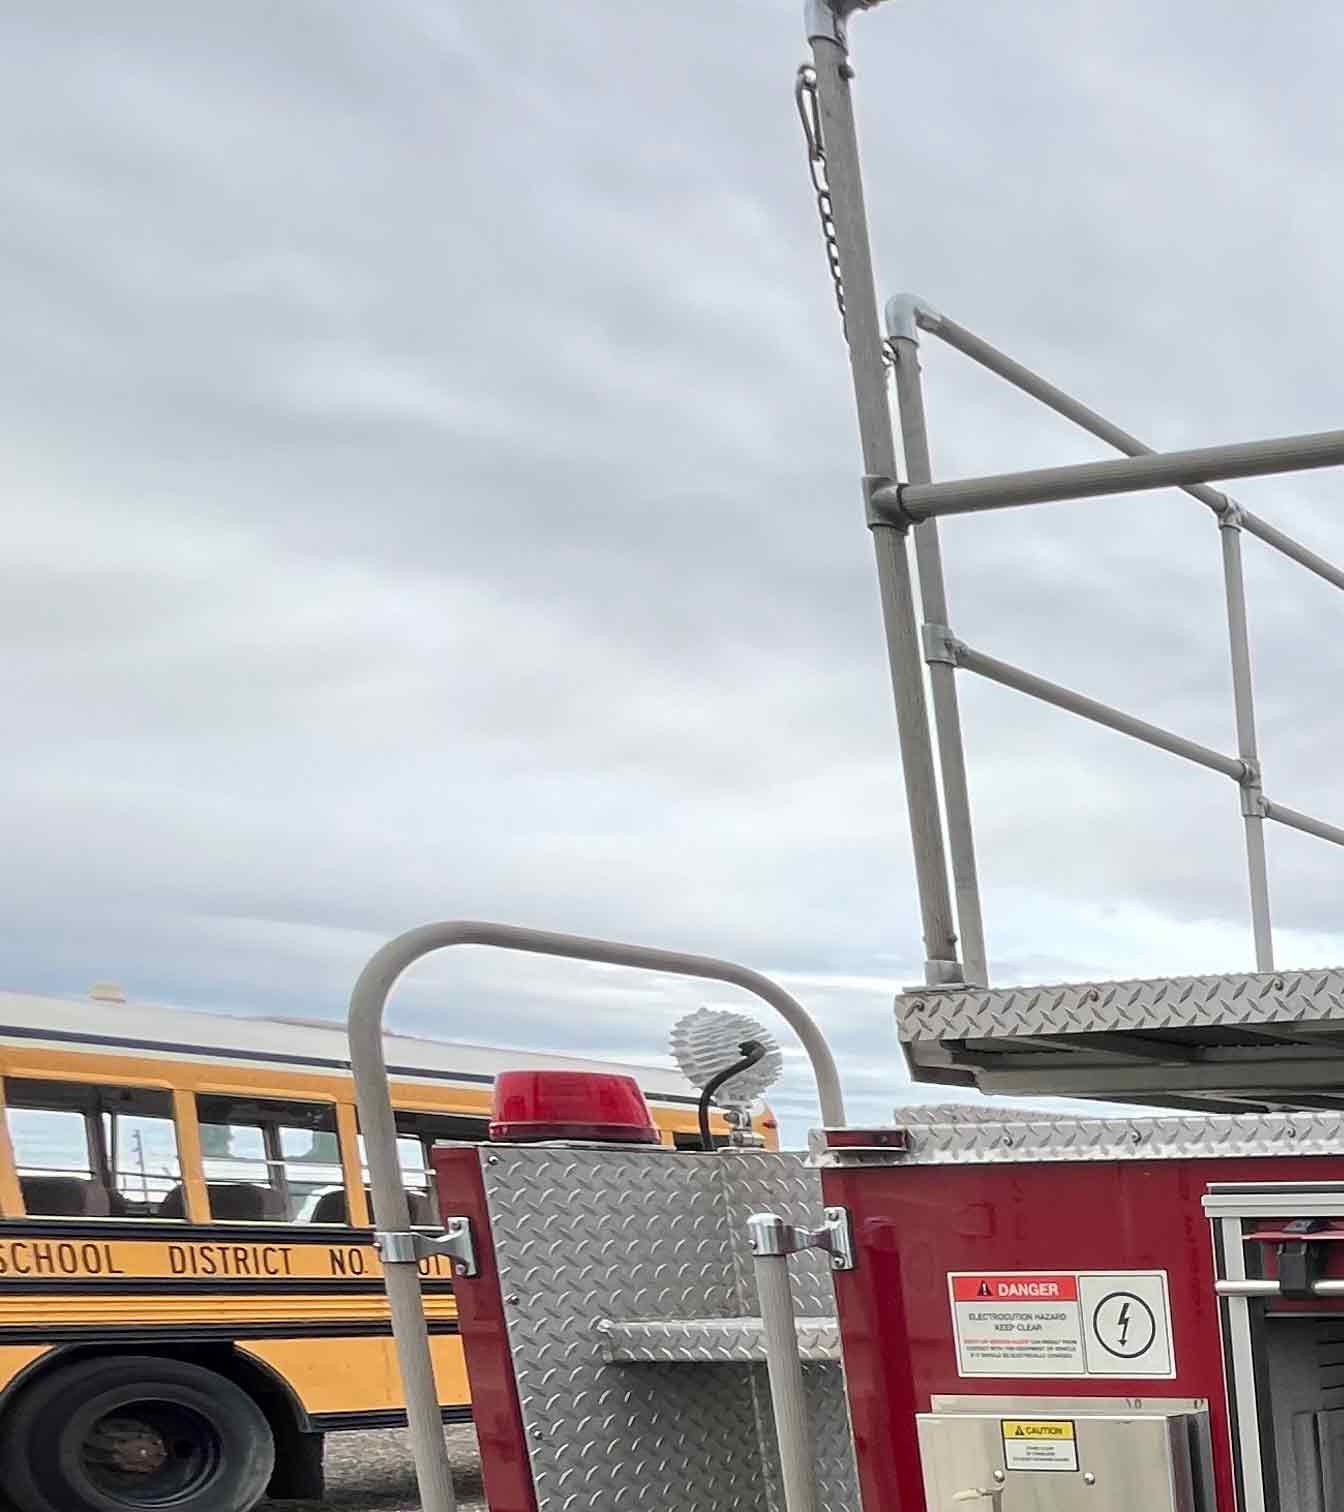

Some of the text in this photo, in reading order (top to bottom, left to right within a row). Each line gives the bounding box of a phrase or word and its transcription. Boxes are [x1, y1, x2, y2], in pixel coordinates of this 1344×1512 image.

[168, 1245, 293, 1277] DISTRICT
[329, 1248, 369, 1276] NO.
[997, 1282, 1060, 1297] DANGER
[968, 1312, 1067, 1322] ELECTROCUTION HAZARD
[994, 1323, 1043, 1332] KEEP CLEAR
[1025, 1425, 1064, 1435] CAUTION
